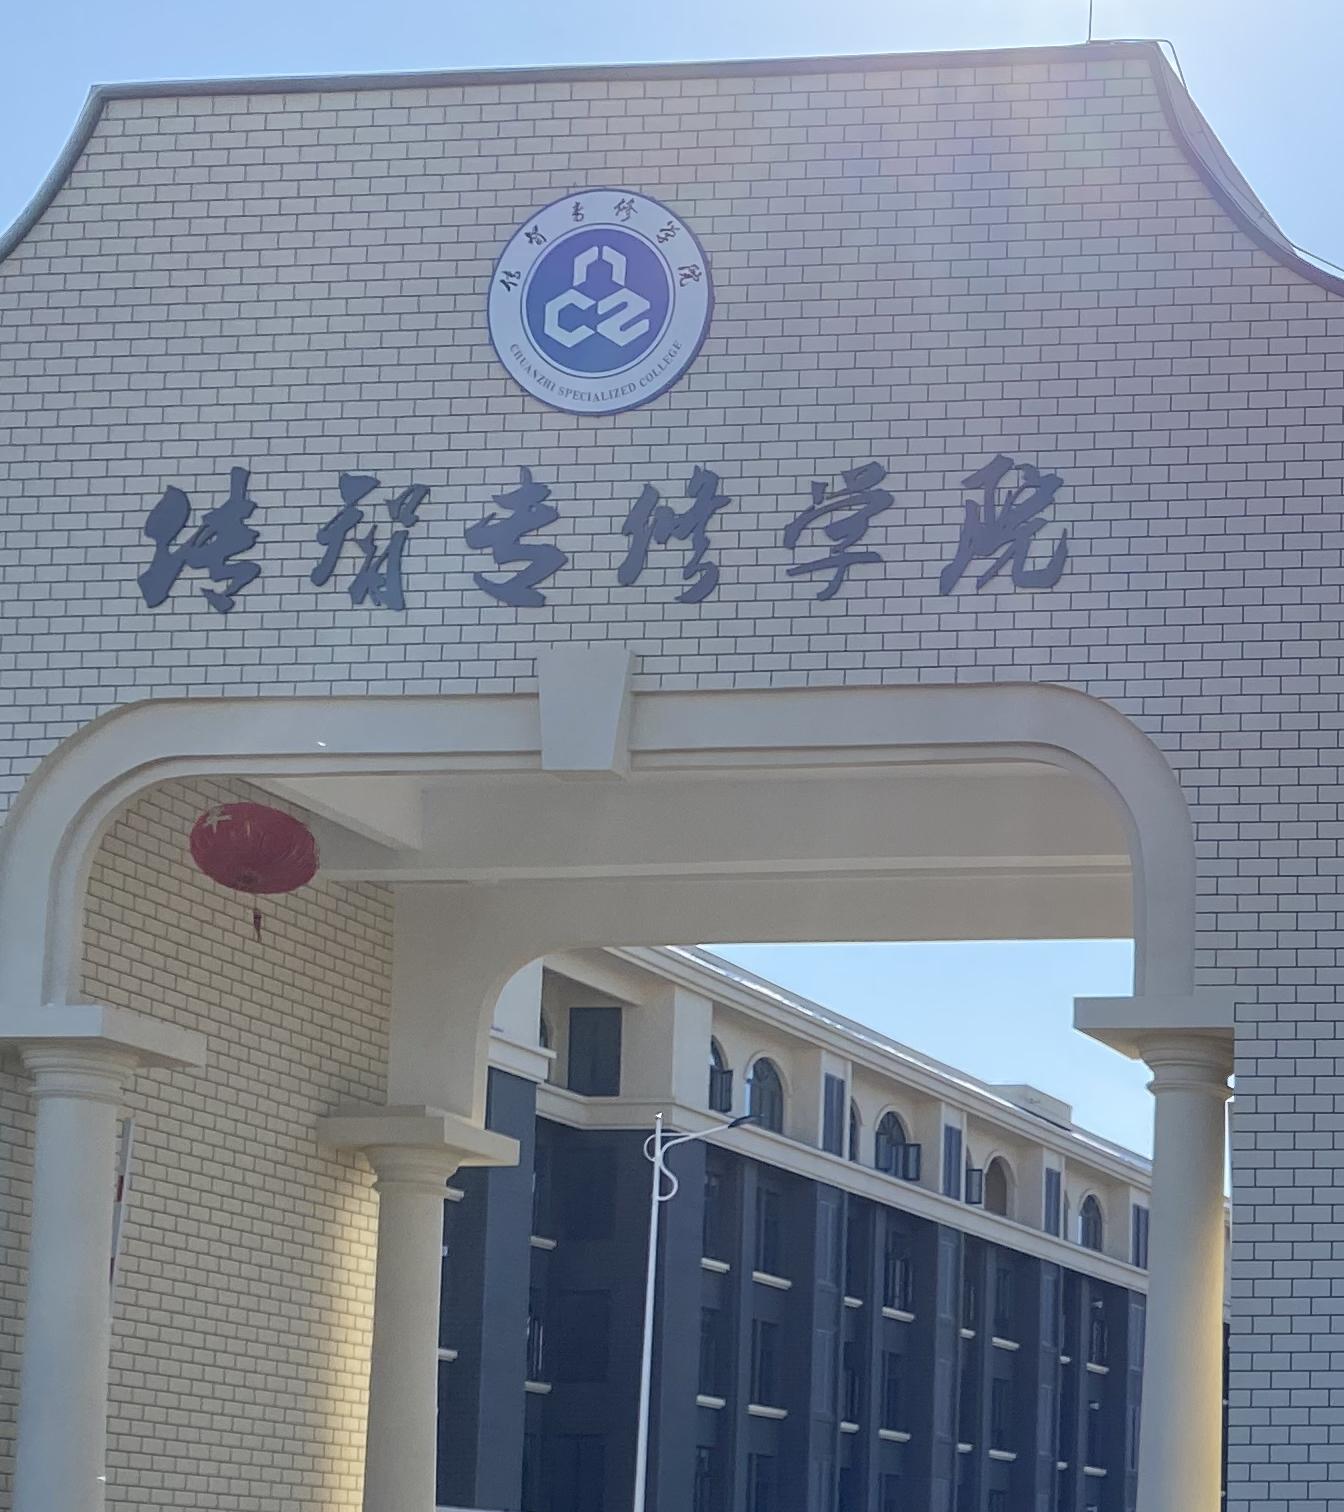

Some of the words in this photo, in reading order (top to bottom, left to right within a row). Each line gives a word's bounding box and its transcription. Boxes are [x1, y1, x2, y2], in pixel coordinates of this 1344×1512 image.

[509, 343, 556, 392] CHUANZHI
[557, 382, 637, 402] SPECIALIZED
[638, 341, 682, 388] COLLEGE
[136, 453, 1070, 614] 传智专修学院
